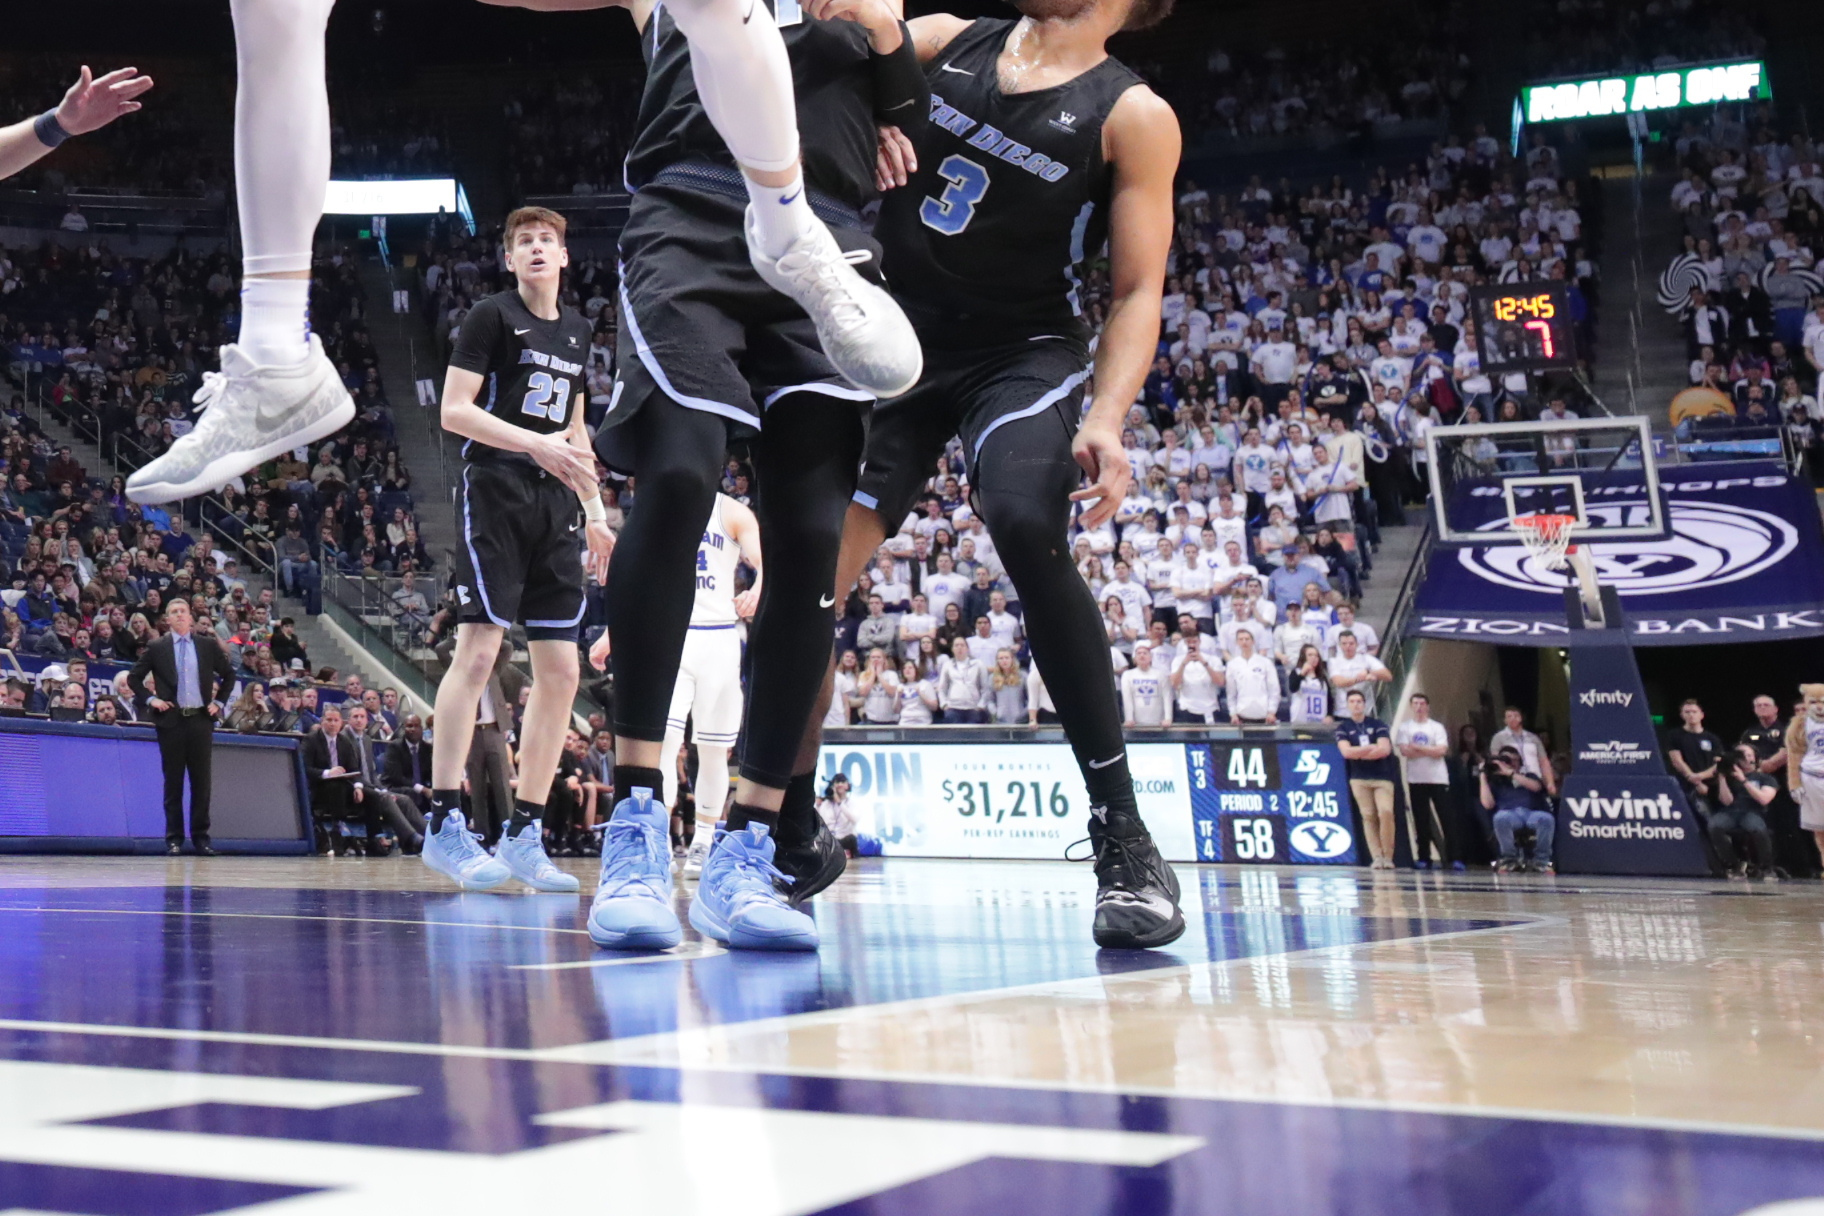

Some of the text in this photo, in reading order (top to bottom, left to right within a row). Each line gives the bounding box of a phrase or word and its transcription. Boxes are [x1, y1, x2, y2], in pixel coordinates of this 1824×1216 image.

[965, 123, 1069, 182] DIEGO
[919, 154, 991, 236] 3
[1494, 294, 1554, 321] 12:45
[1524, 320, 1554, 358] 7
[521, 372, 570, 424] 23
[1419, 610, 1824, 635] ZION BANK
[1307, 695, 1322, 715] 18
[1579, 689, 1633, 707] xfinity
[1191, 750, 1206, 767] TF
[1228, 748, 1267, 788] 44
[1133, 780, 1175, 794] D.COM
[1195, 771, 1206, 789] 3
[942, 778, 1069, 823] $31,216
[1220, 794, 1279, 812] PERIOD 2
[1287, 791, 1339, 818] 12:45
[1566, 789, 1682, 821] vivint.
[1198, 820, 1213, 837] TF
[1233, 818, 1274, 859] 58
[1569, 821, 1685, 840] SmartHome
[1203, 839, 1215, 859] 4
